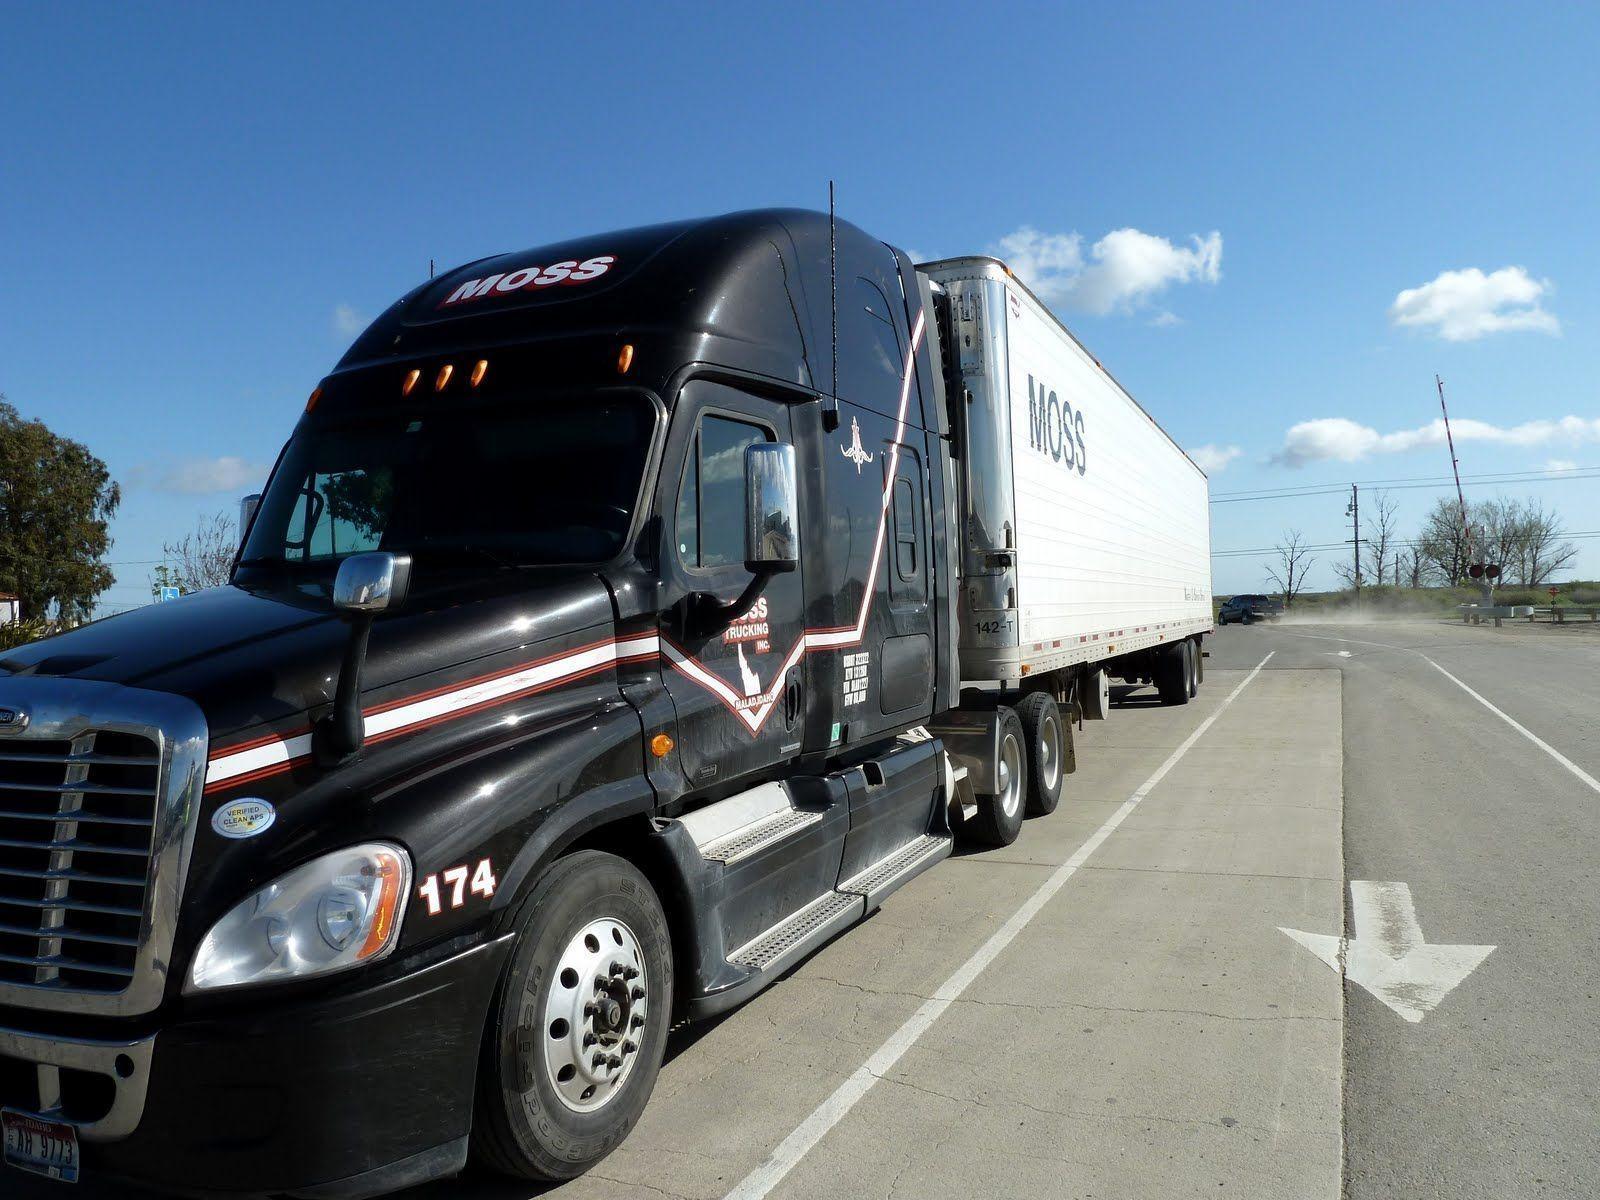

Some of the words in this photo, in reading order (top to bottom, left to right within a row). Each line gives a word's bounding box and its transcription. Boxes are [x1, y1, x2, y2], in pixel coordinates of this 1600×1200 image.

[444, 255, 615, 304] MOSS
[1027, 373, 1086, 477] MOSS
[725, 622, 769, 640] TRUCKING
[974, 620, 1014, 635] 142-T
[223, 815, 248, 825] CLEAN
[227, 806, 260, 817] VERIFIED
[419, 857, 496, 916] 174
